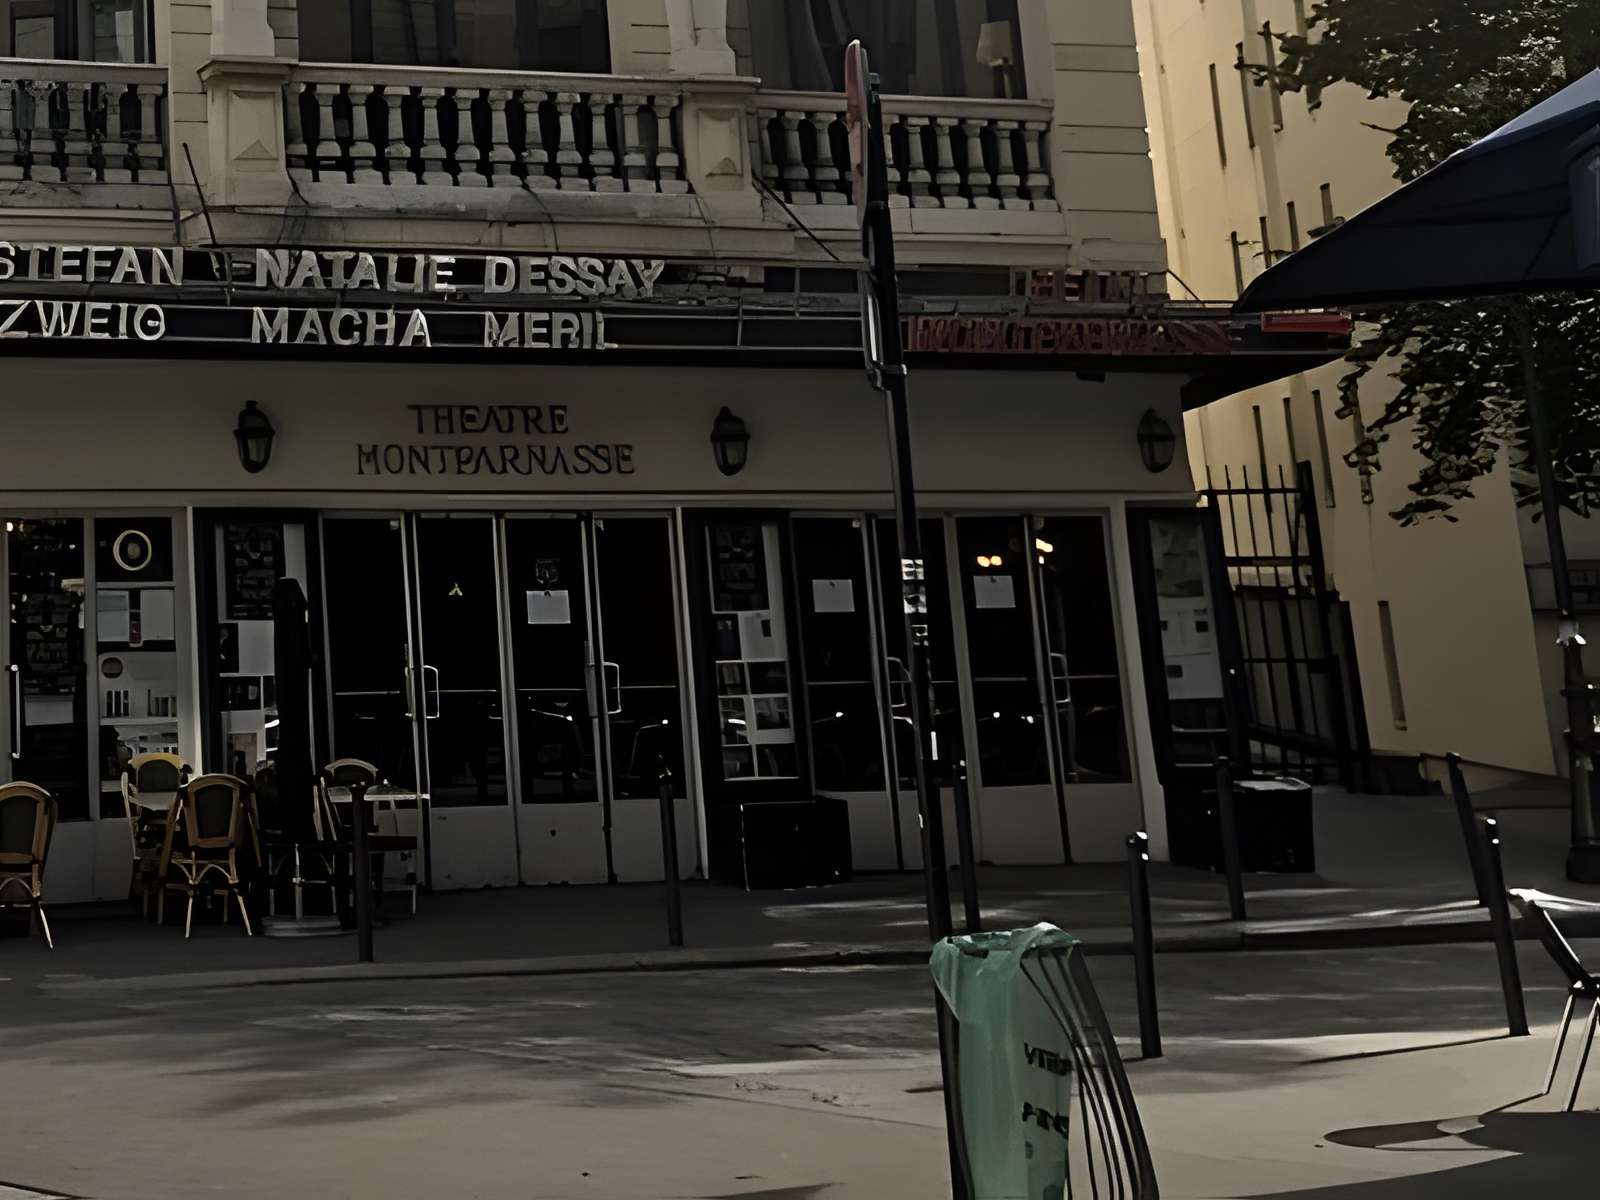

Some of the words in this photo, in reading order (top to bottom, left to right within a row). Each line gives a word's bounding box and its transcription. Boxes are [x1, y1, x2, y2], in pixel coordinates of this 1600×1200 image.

[255, 247, 456, 293] NATALIE
[484, 255, 665, 299] DESSAY
[250, 306, 432, 348] MACHA
[407, 404, 569, 434] THEATRE
[356, 443, 635, 476] MONTPARNASSE
